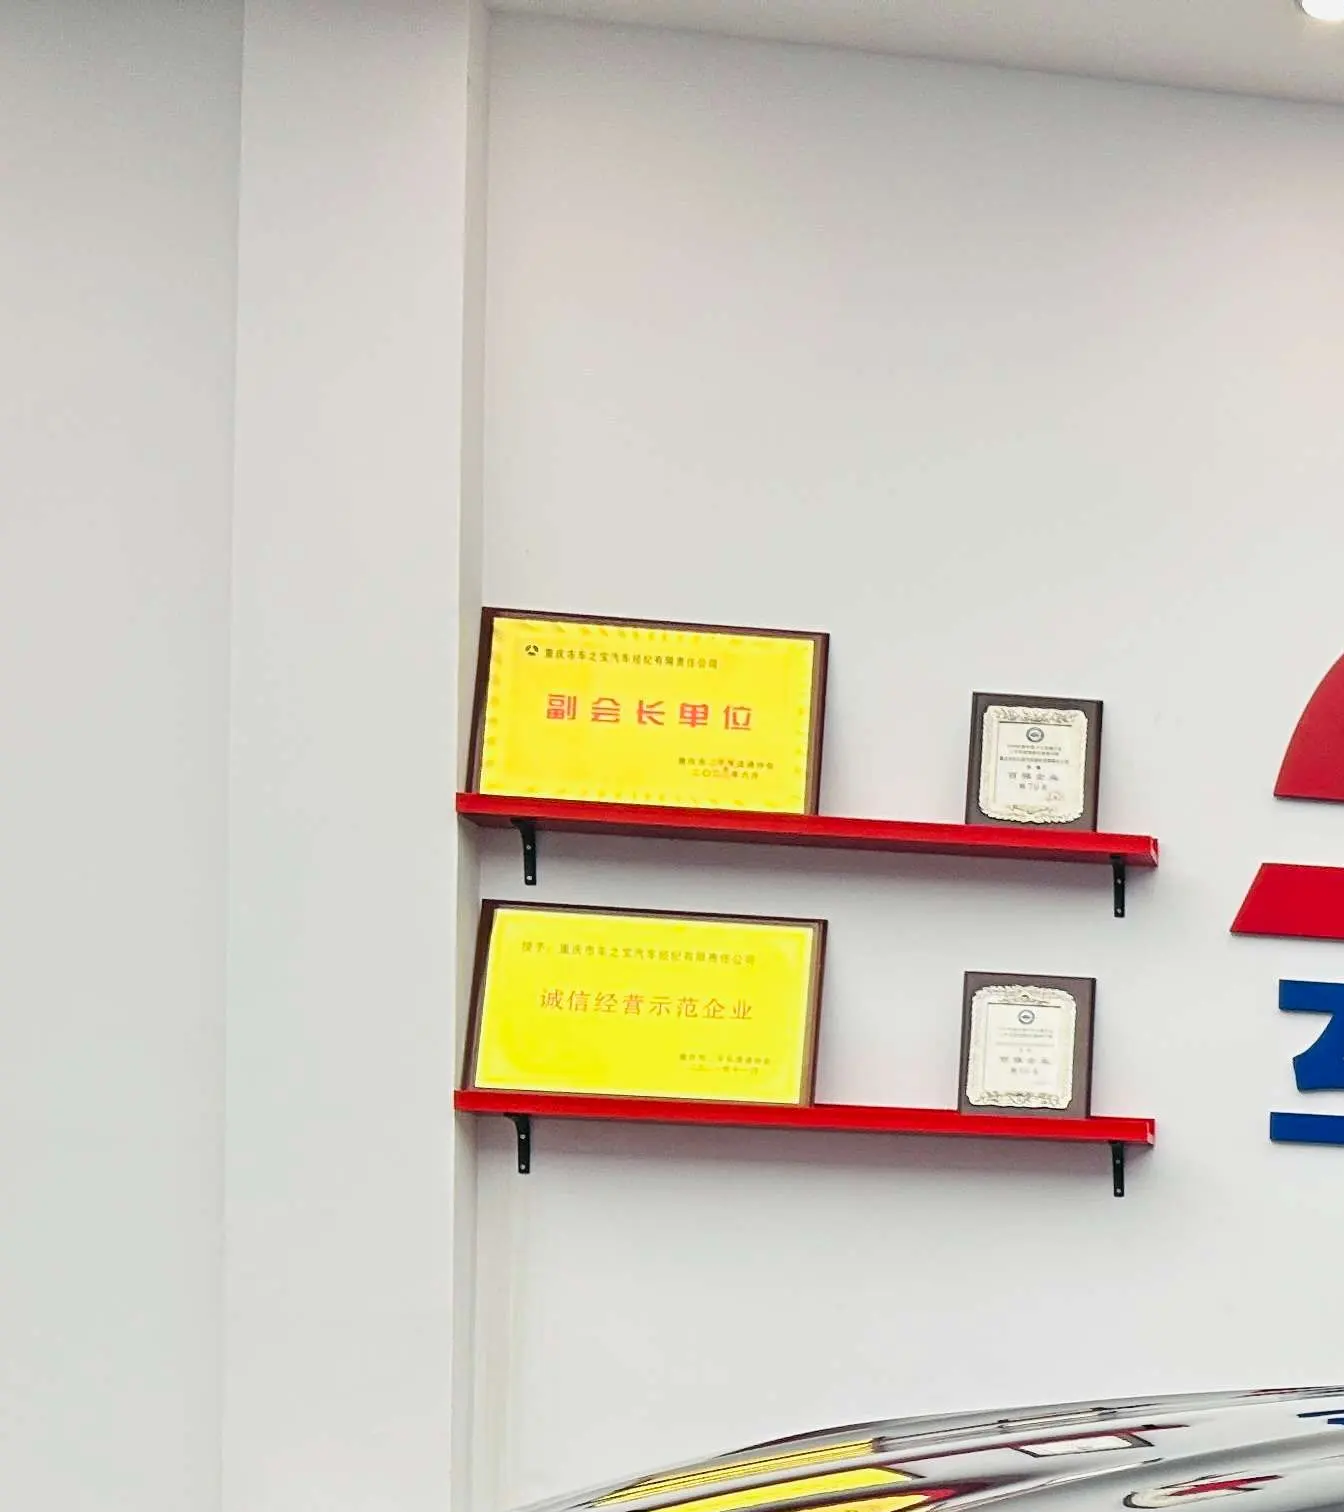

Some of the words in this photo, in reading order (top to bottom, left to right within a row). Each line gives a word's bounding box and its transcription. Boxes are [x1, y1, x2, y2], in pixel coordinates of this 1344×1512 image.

[546, 693, 752, 731] 副会长单位
[540, 988, 753, 1021] 诚信经营示范企业
